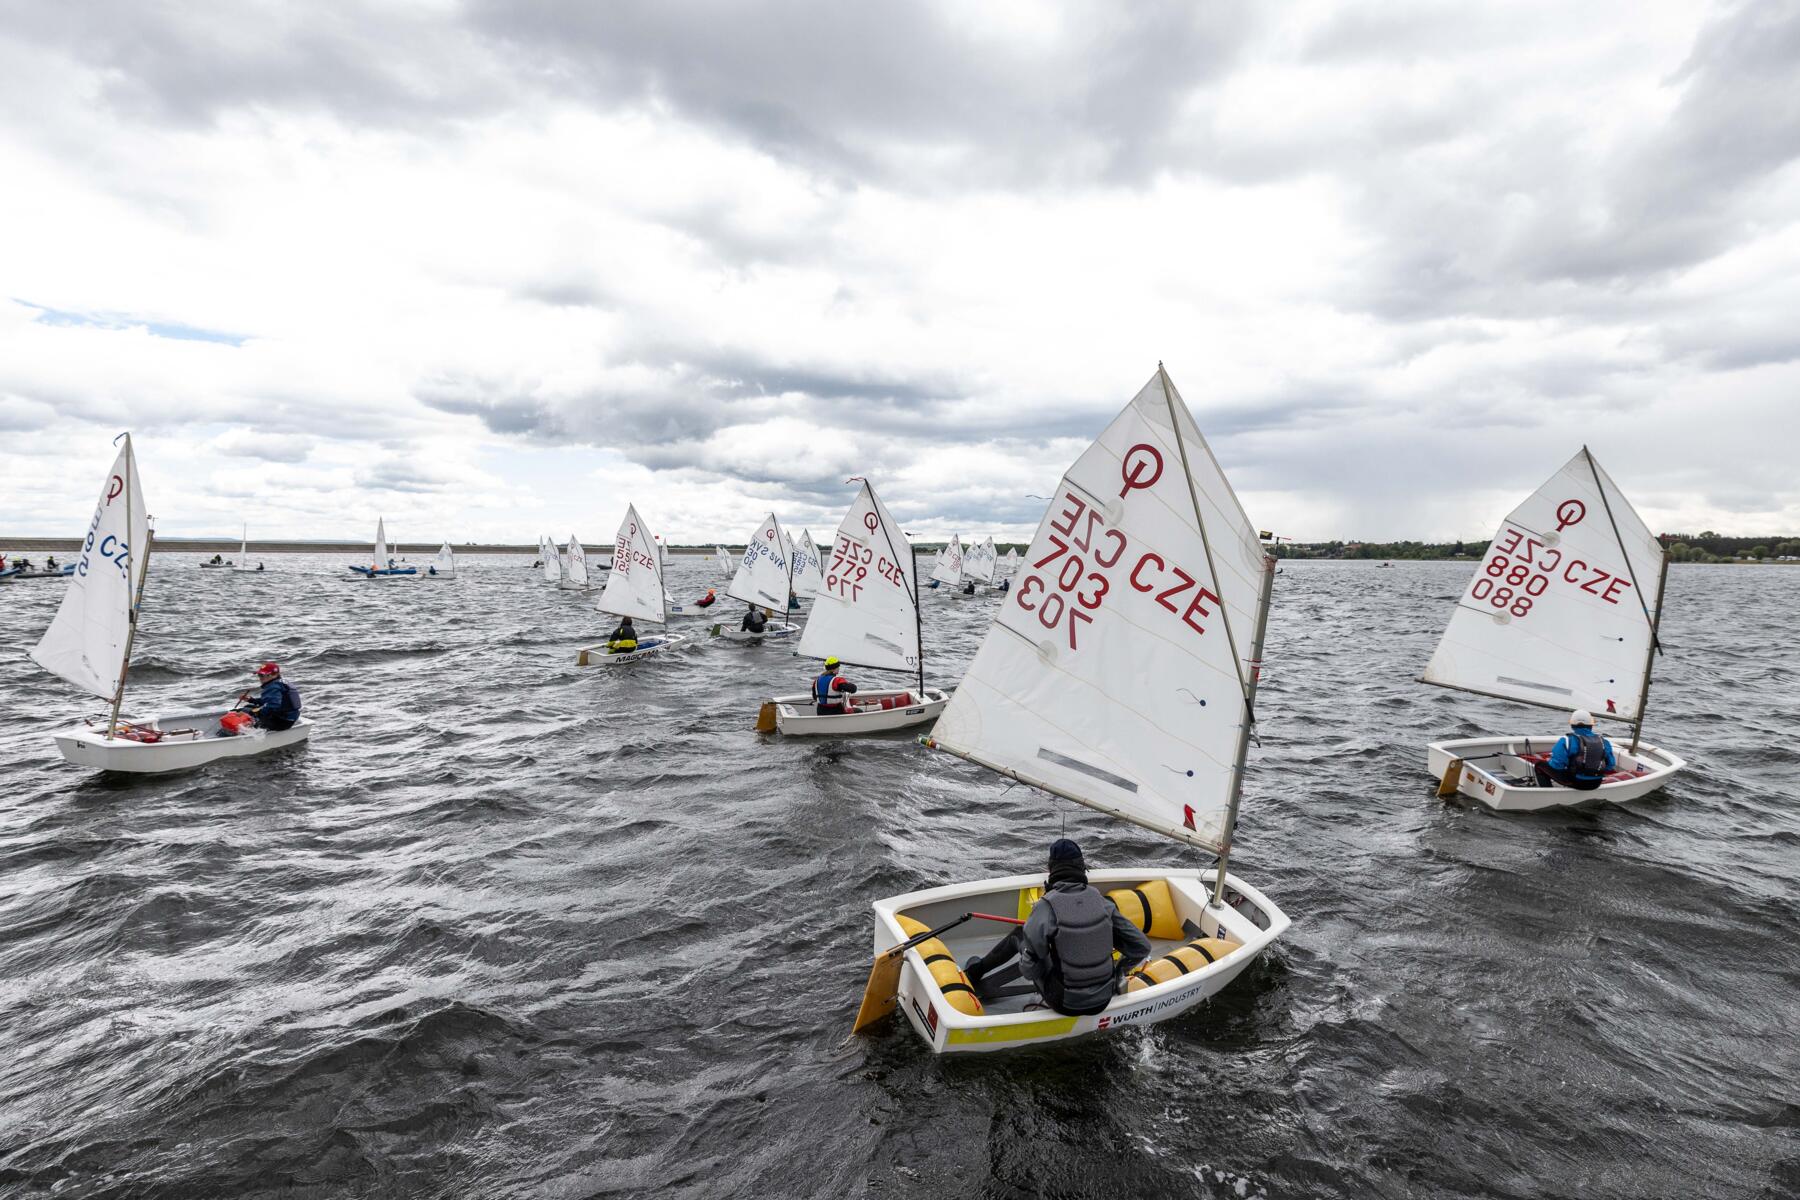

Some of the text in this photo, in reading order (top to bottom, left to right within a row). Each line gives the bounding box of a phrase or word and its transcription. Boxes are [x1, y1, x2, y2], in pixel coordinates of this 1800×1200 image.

[633, 551, 653, 570] CZE
[769, 552, 786, 570] SVK
[831, 554, 867, 582] 779
[878, 557, 903, 588] CZE
[1033, 534, 1109, 609] 703
[1486, 555, 1549, 597] 880
[1130, 553, 1222, 635] CZE
[1563, 560, 1632, 604] CZE
[1113, 986, 1202, 1025] WÜRTH INDUSTRY
